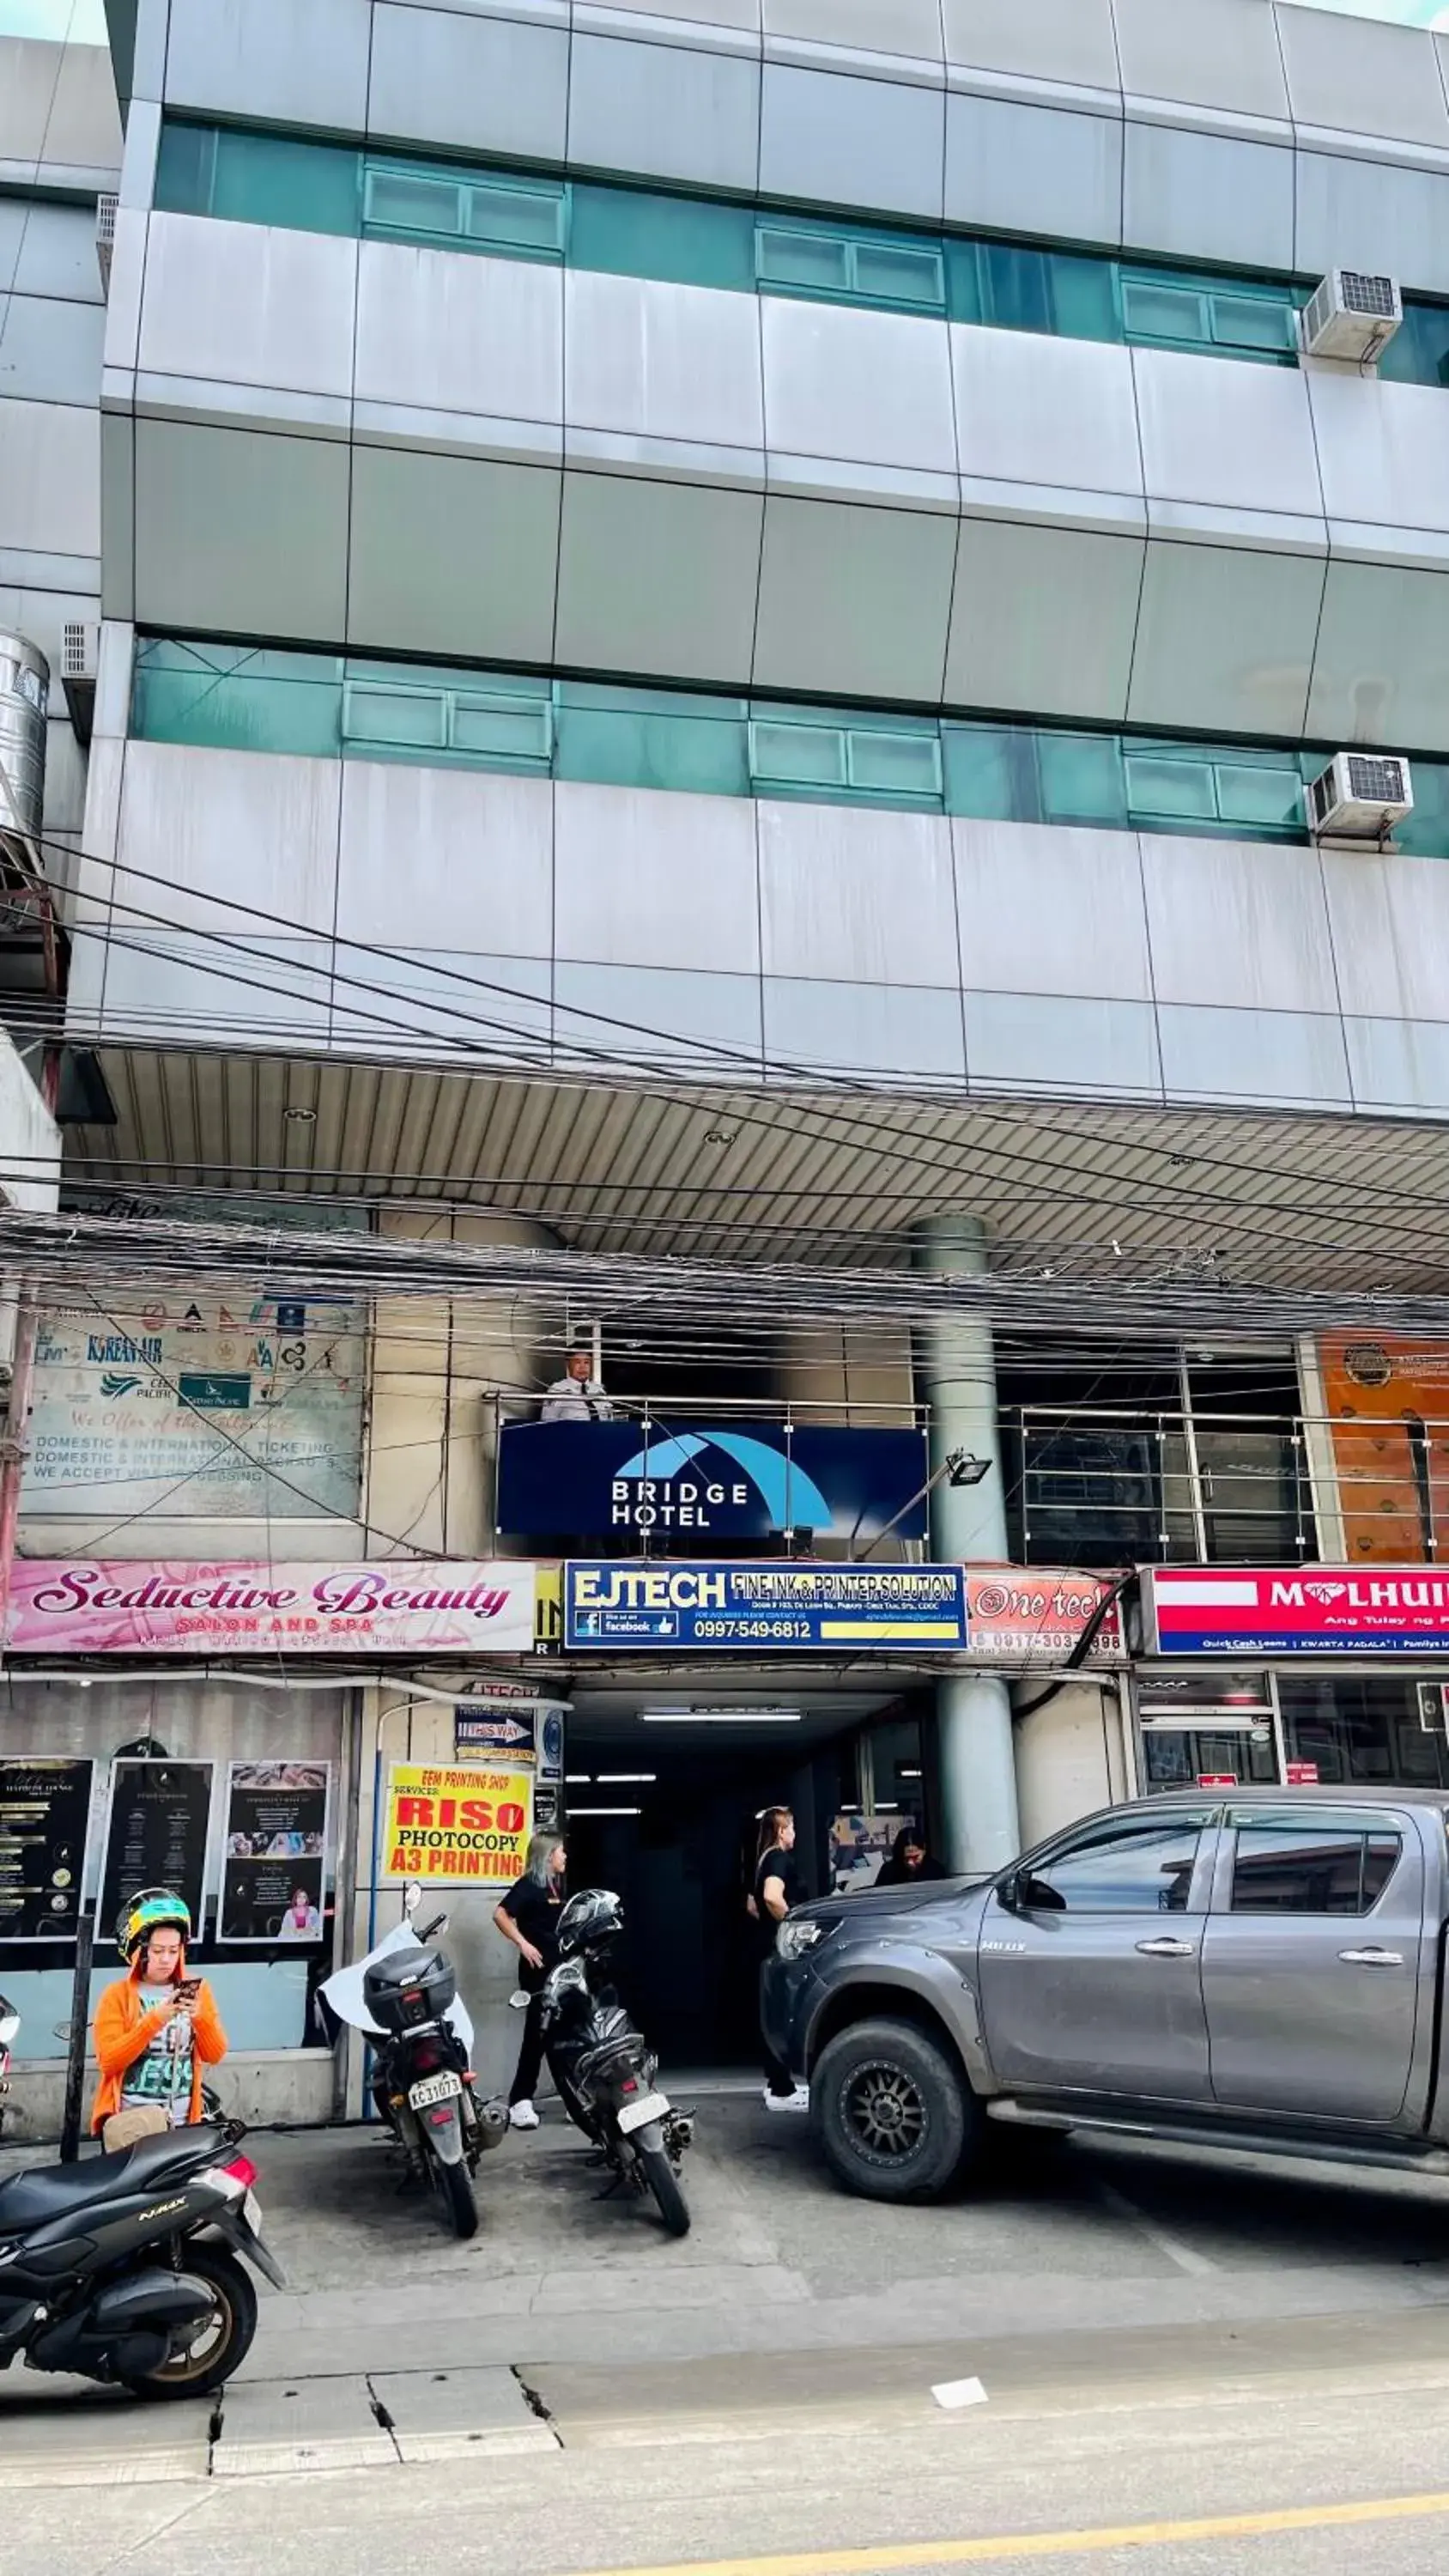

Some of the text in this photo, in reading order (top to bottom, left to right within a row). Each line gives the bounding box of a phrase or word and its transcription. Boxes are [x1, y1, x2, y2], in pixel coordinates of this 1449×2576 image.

[37, 1437, 114, 1449] DOMESTIC
[134, 1437, 252, 1453] INTERNATIONAL
[258, 1442, 334, 1454] TICKETING
[35, 1452, 114, 1463] DOMESTIC
[34, 1467, 56, 1478] WE
[61, 1467, 121, 1479] ACCEPT
[612, 1481, 748, 1504] BRIDGE
[612, 1504, 710, 1526] HOTEL
[33, 1570, 511, 1619] Seductive Beauty
[574, 1571, 726, 1608] EJTECH
[1347, 1582, 1449, 1607] LHUI
[975, 1585, 1046, 1618] One
[175, 1618, 374, 1633] SALON AND SPA
[605, 1621, 650, 1631] facebook
[694, 1621, 811, 1637] 0997-549-6812
[1325, 1616, 1358, 1625] Ang
[1363, 1616, 1407, 1625] Tulay
[1413, 1617, 1434, 1625] ng
[993, 1633, 1120, 1649] 0917-303-898
[1203, 1639, 1231, 1648] Quick
[1233, 1639, 1256, 1649] Cash
[444, 1771, 488, 1789] PRINTING
[397, 1796, 524, 1833] RISO
[398, 1830, 519, 1852] PHOTOCOPY
[391, 1848, 524, 1878] A3 PRINTING
